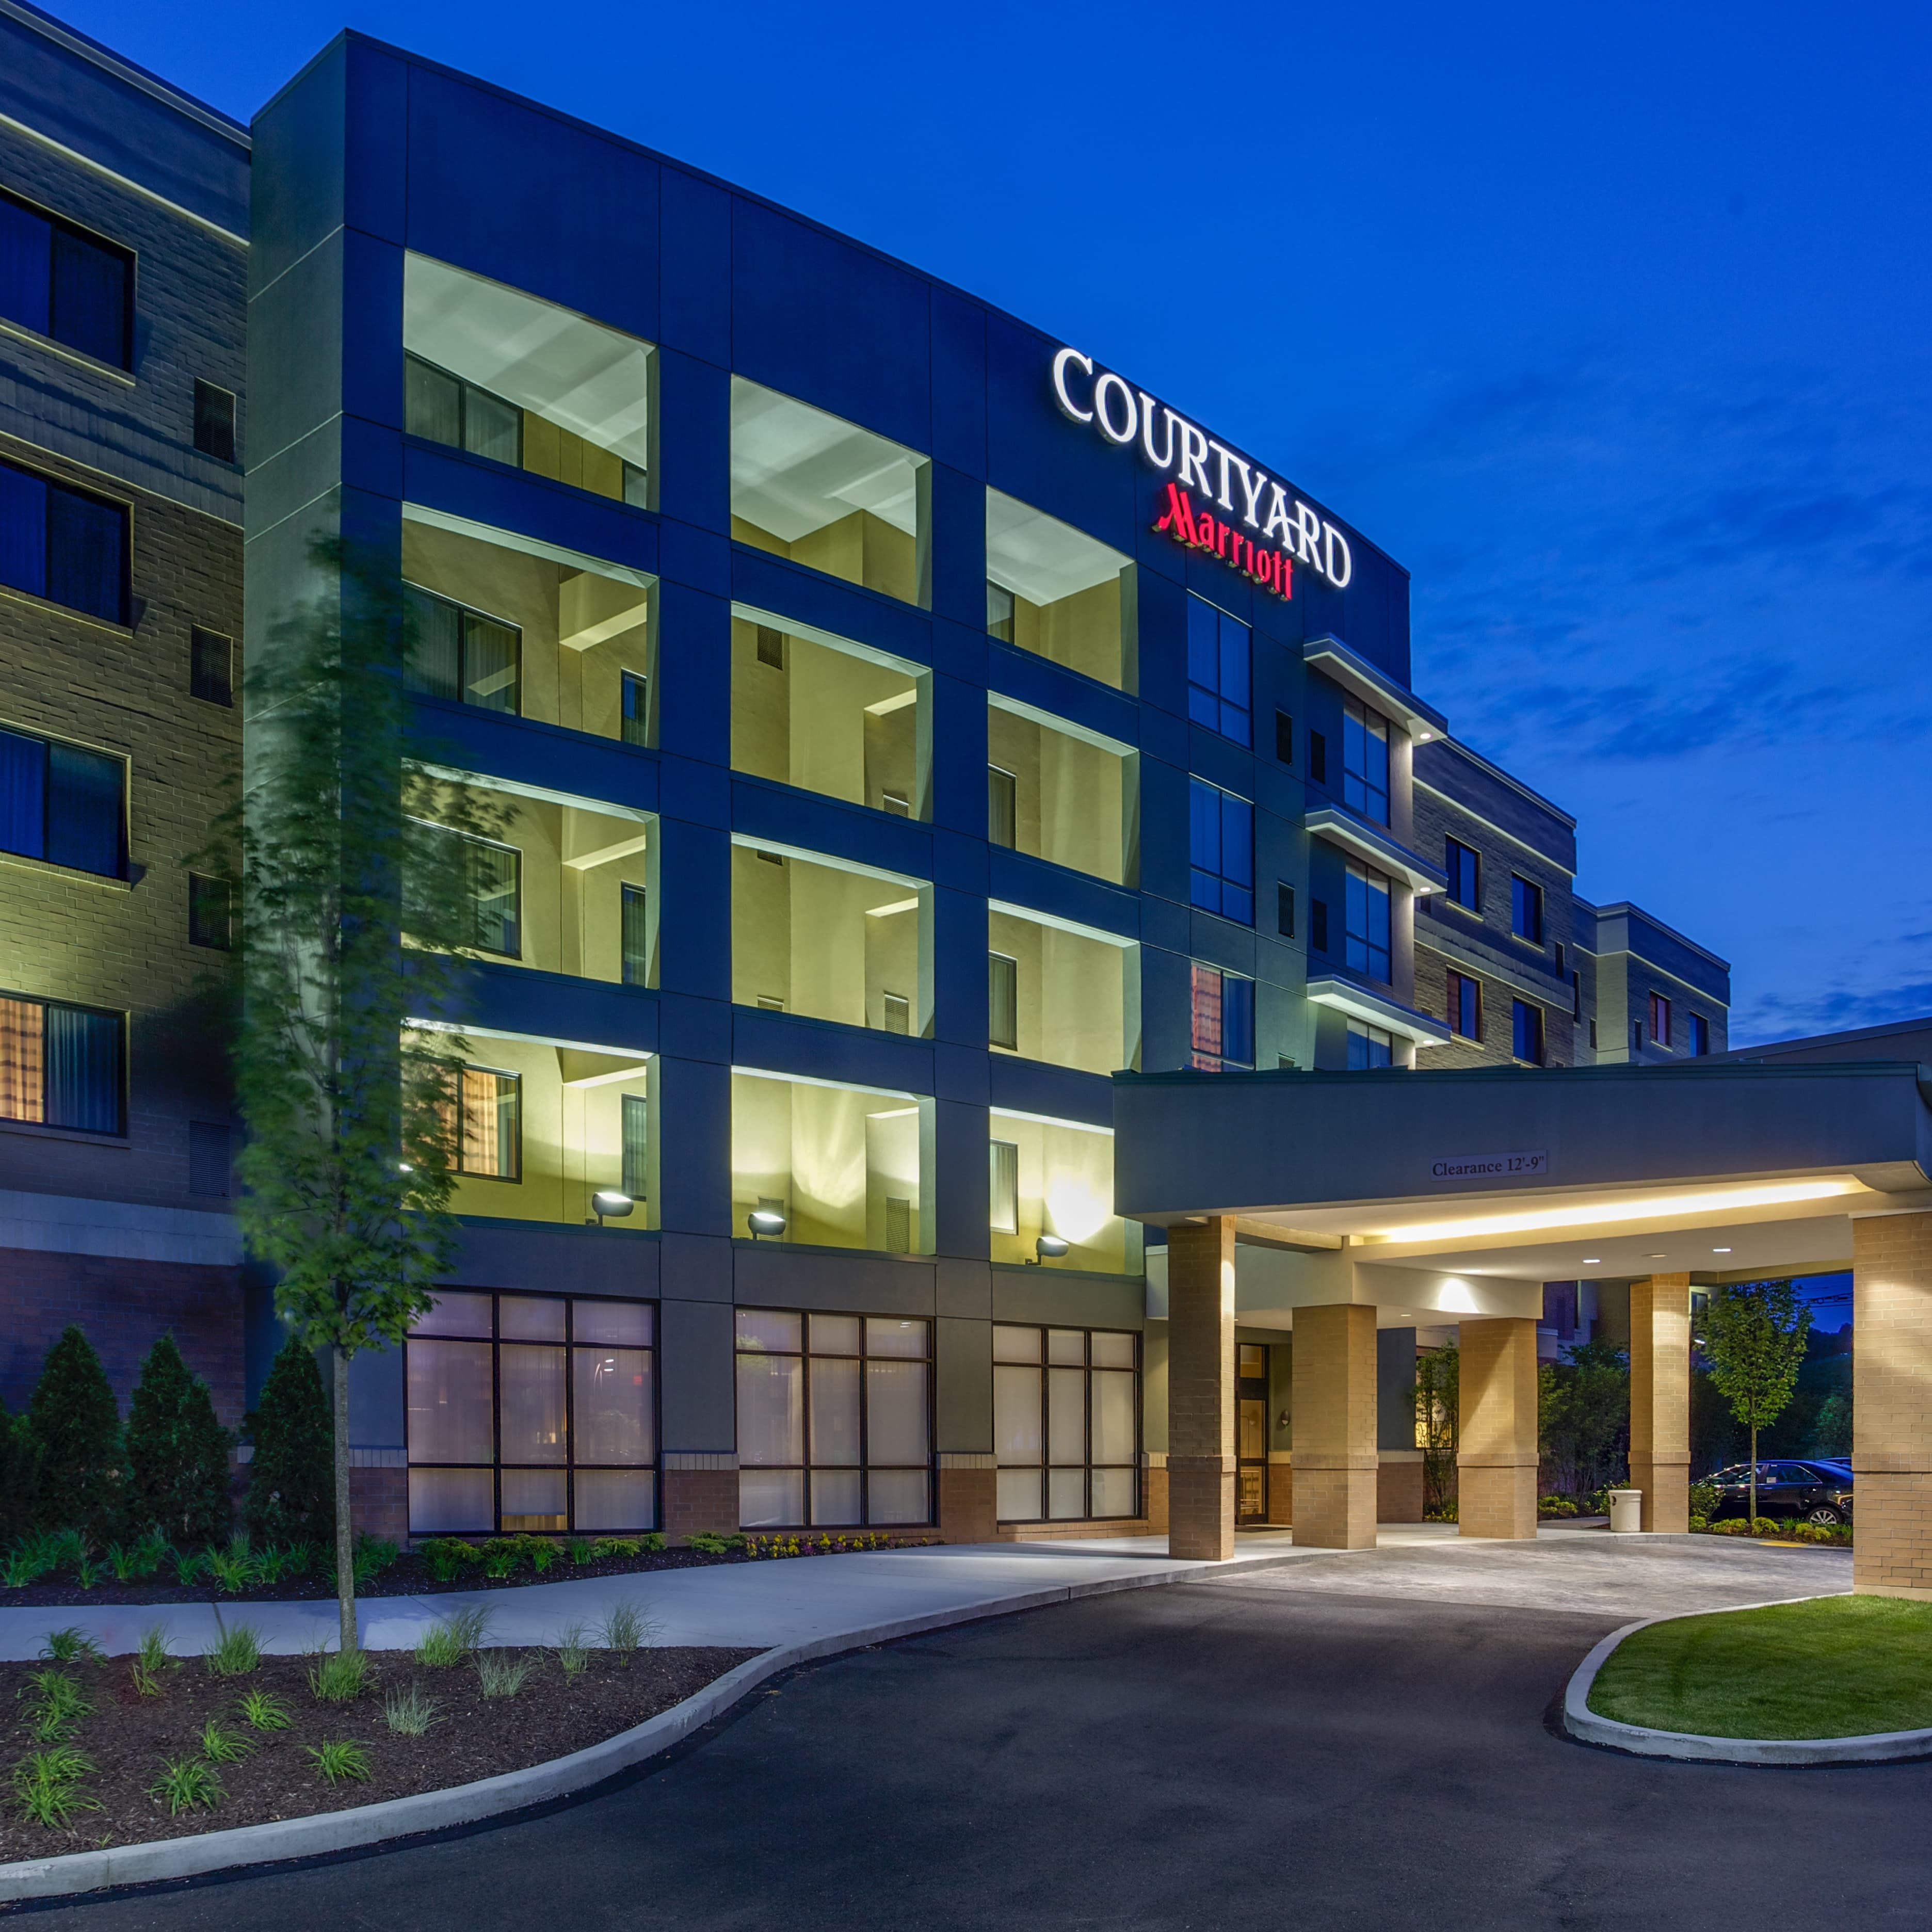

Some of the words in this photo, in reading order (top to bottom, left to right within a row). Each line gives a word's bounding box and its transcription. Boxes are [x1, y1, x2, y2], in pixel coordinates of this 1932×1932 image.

[1054, 348, 1351, 587] COURTYARD
[1156, 483, 1293, 601] Marriott
[1432, 1163, 1502, 1176] Clearance
[1508, 1156, 1544, 1171] 12'-9"
